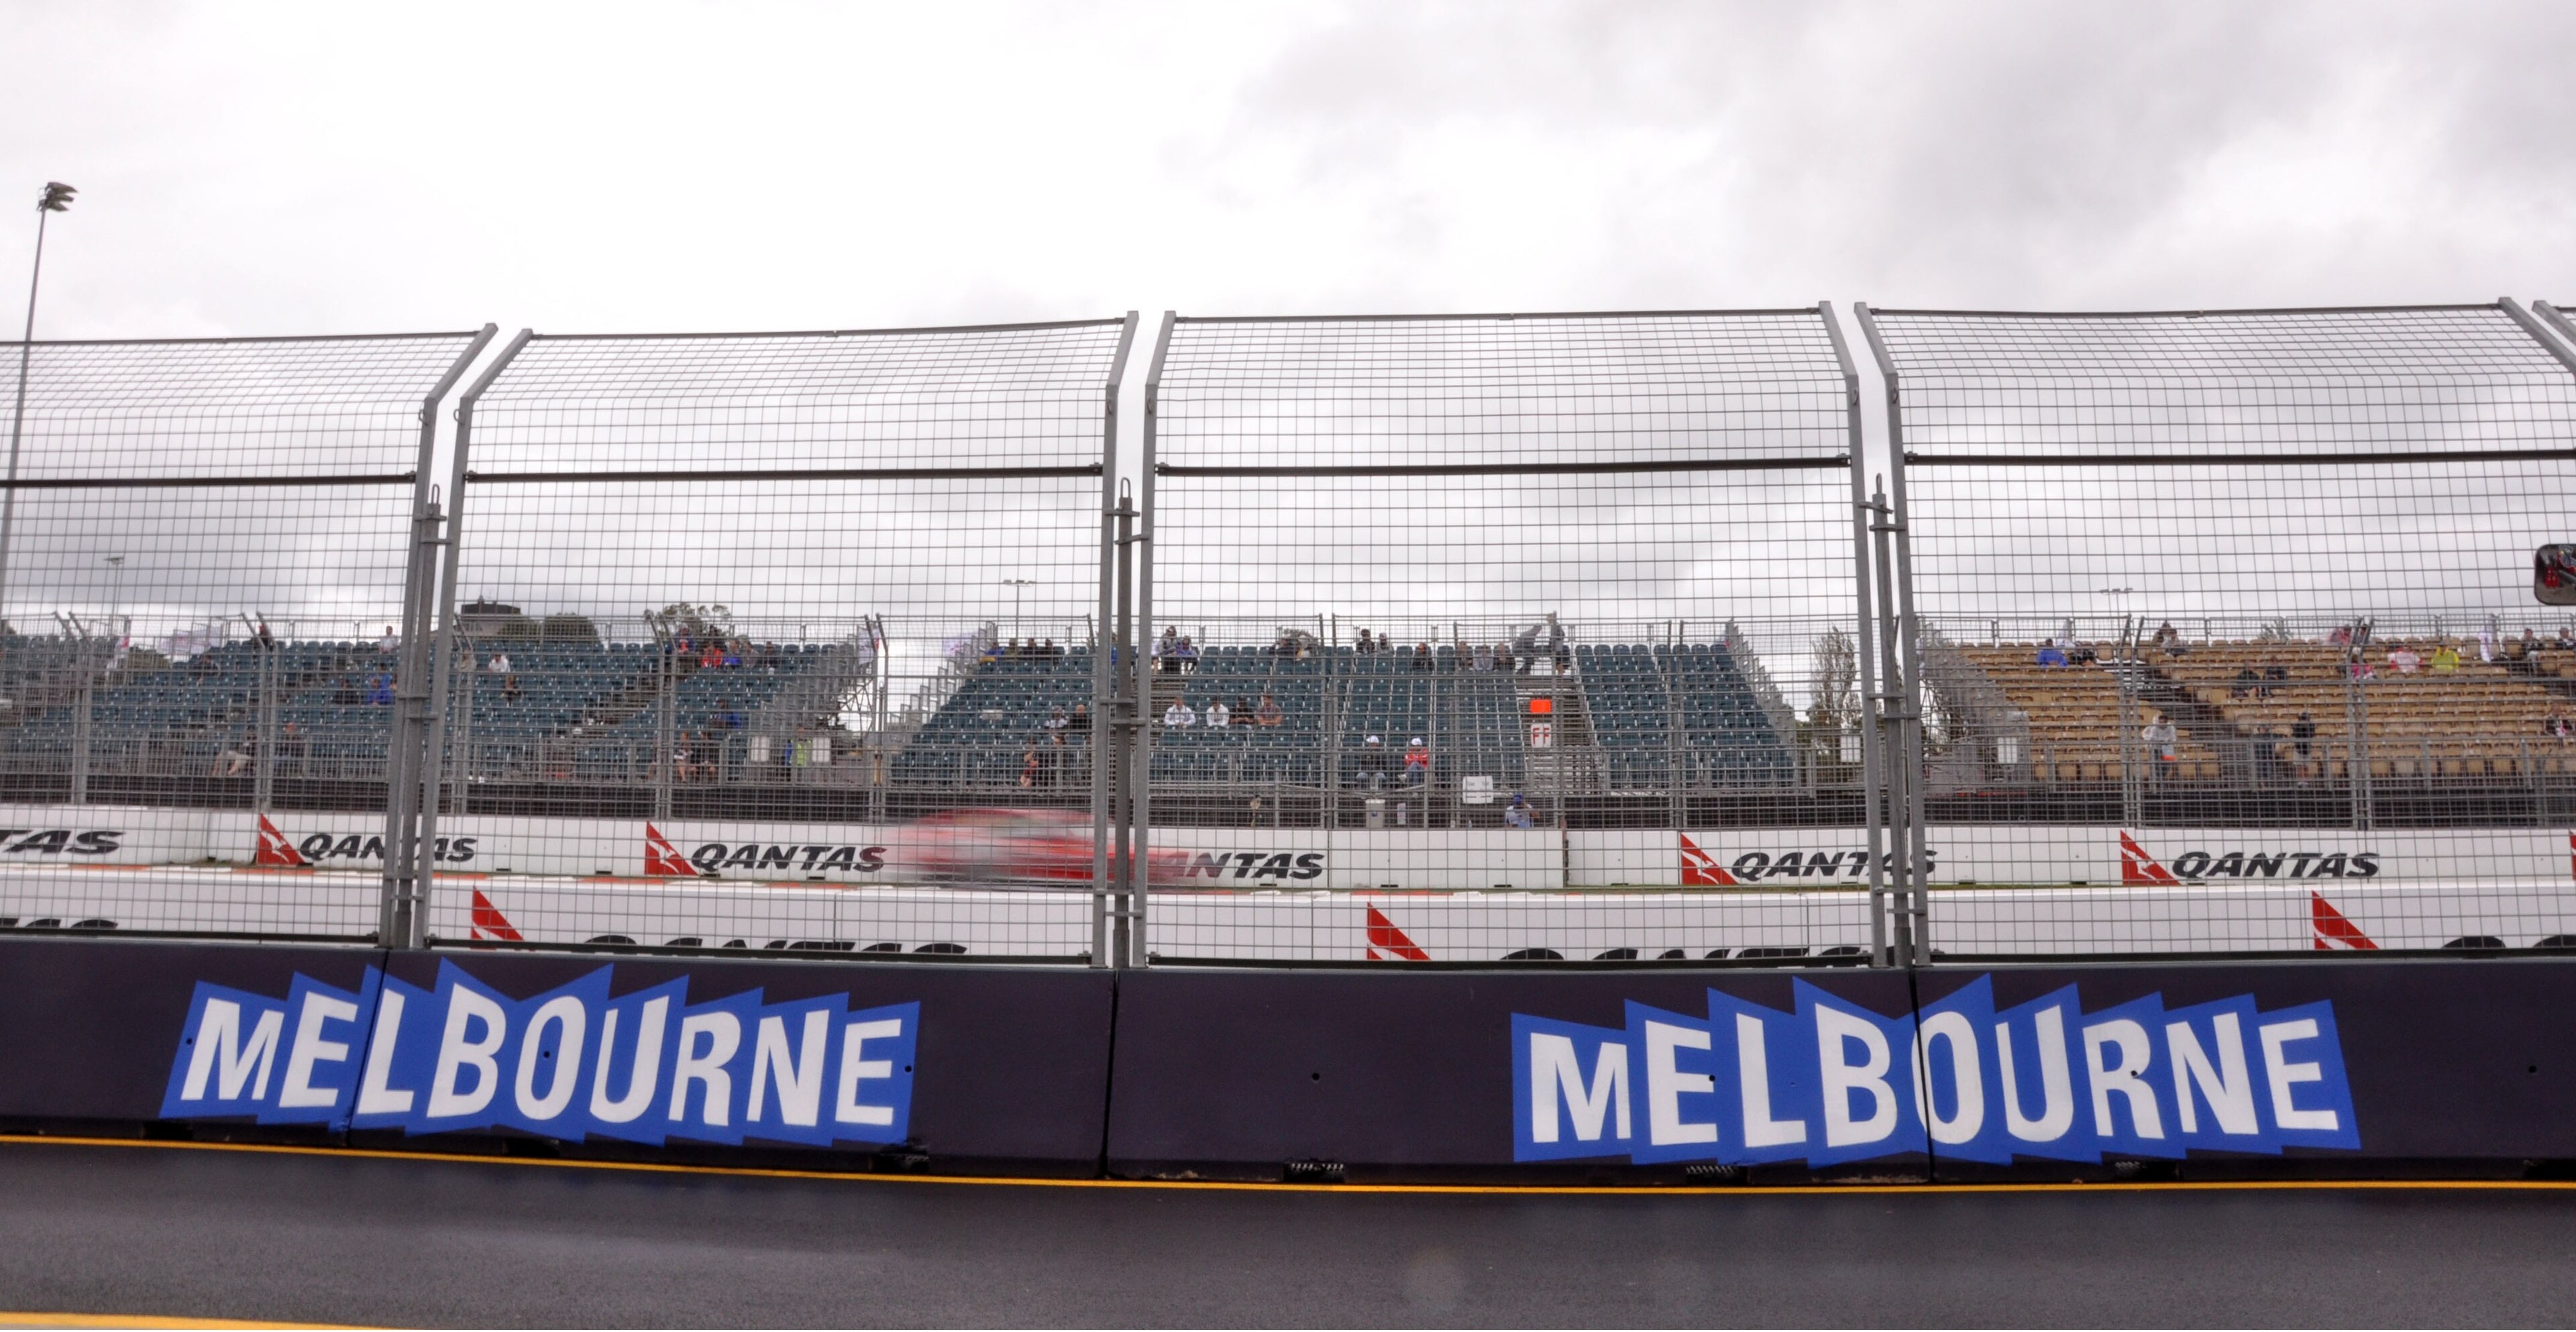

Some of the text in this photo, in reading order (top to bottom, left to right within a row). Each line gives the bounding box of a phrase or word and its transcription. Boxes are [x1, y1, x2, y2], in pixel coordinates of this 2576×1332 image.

[691, 843, 888, 872] QANTAS
[2172, 850, 2379, 879] QANTAS
[180, 983, 902, 1127] MELBOURNE
[1530, 1003, 2339, 1148] MELBOURNE
